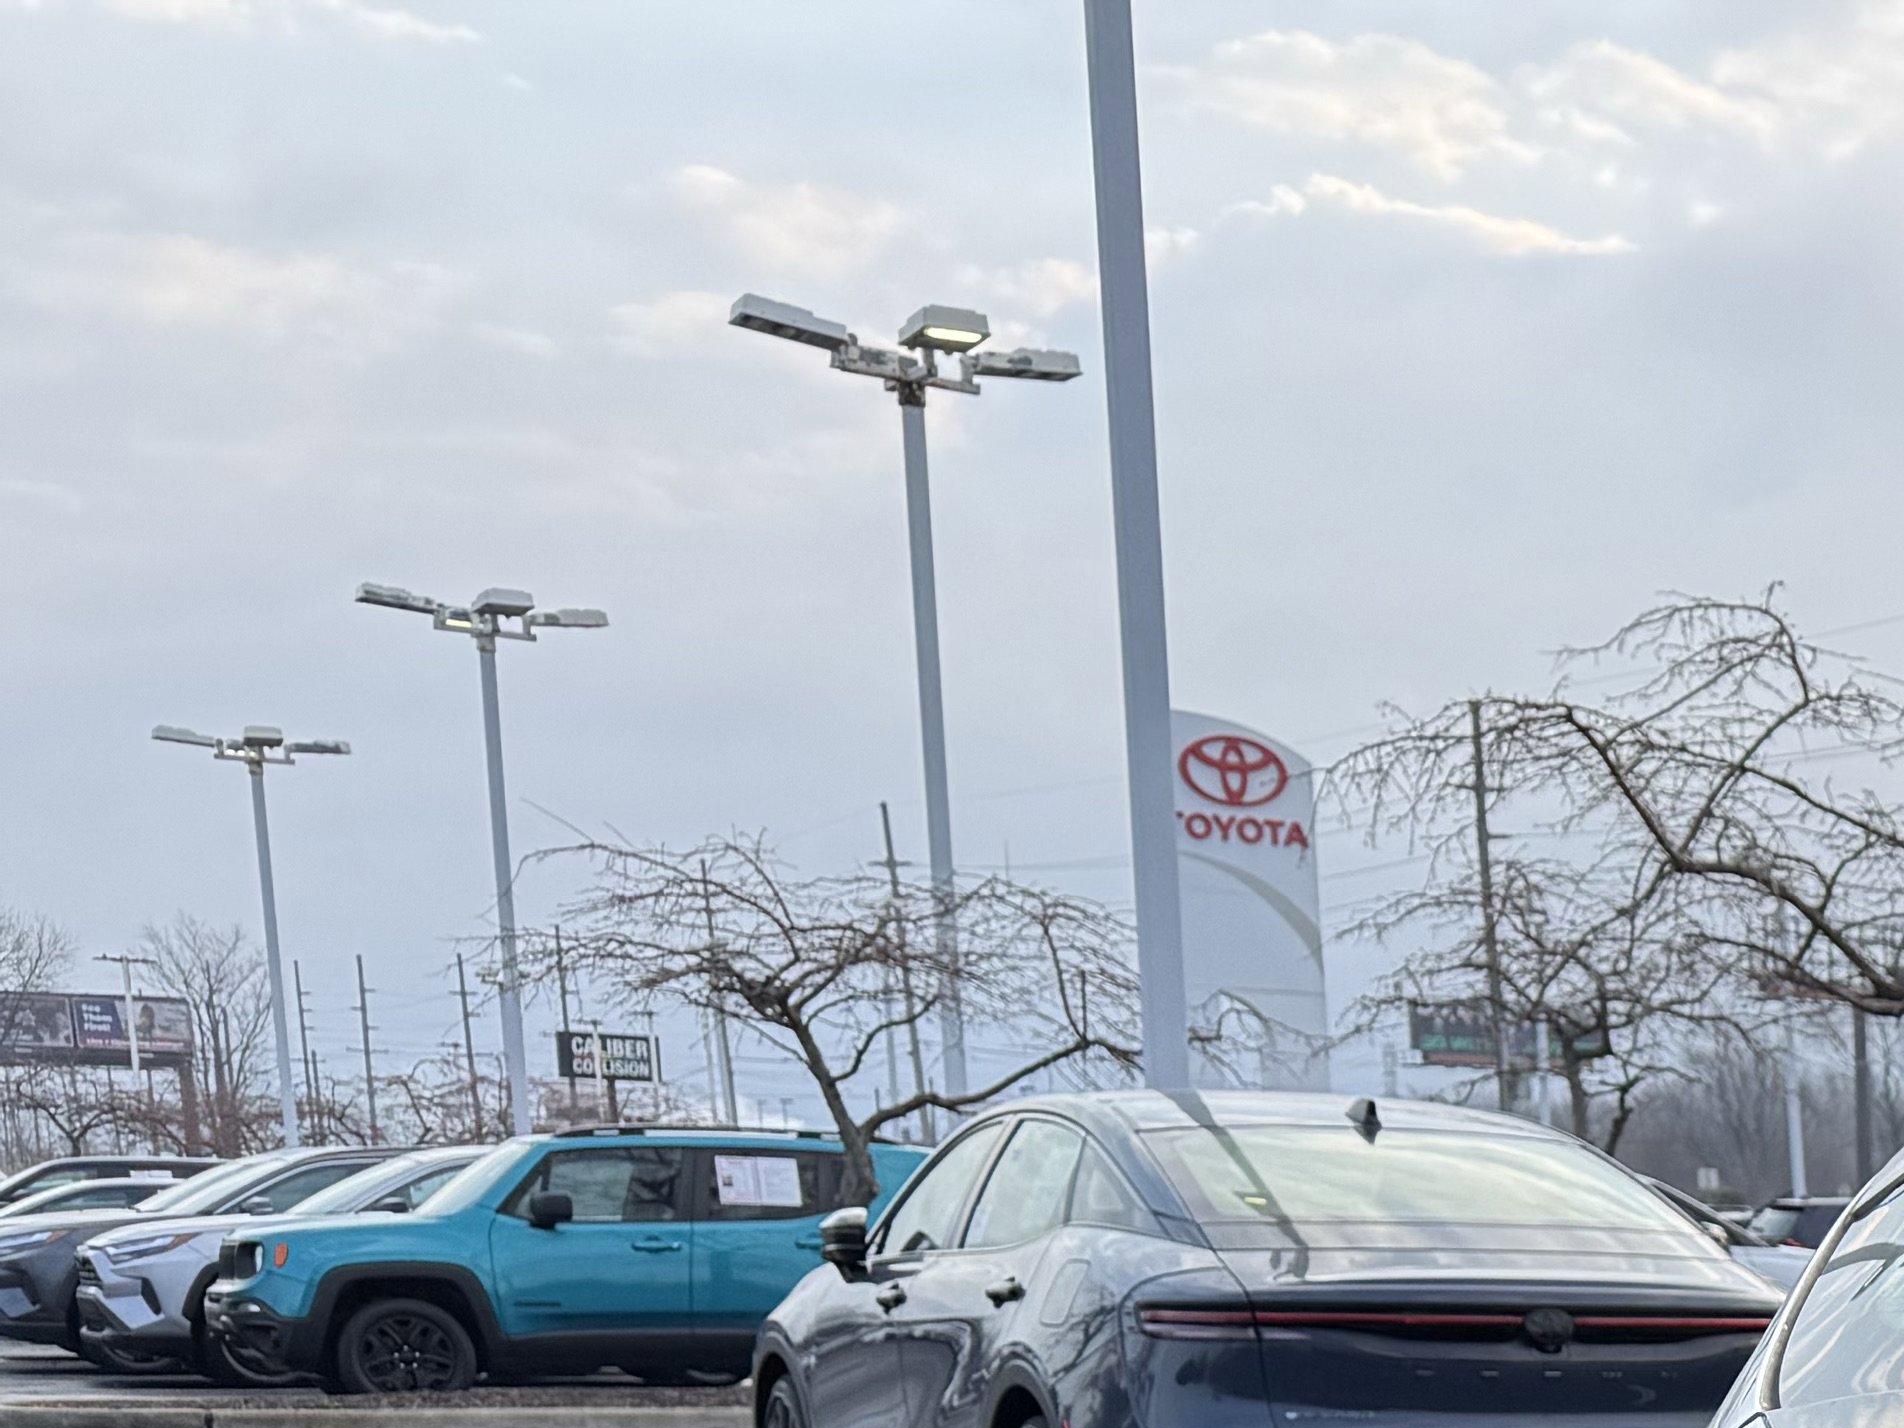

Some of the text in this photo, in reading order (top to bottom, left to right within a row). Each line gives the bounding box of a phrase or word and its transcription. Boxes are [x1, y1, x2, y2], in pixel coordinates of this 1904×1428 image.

[1176, 811, 1309, 848] OYOTA
[571, 1036, 648, 1060] CAIBER
[573, 1058, 649, 1077] COLISION
